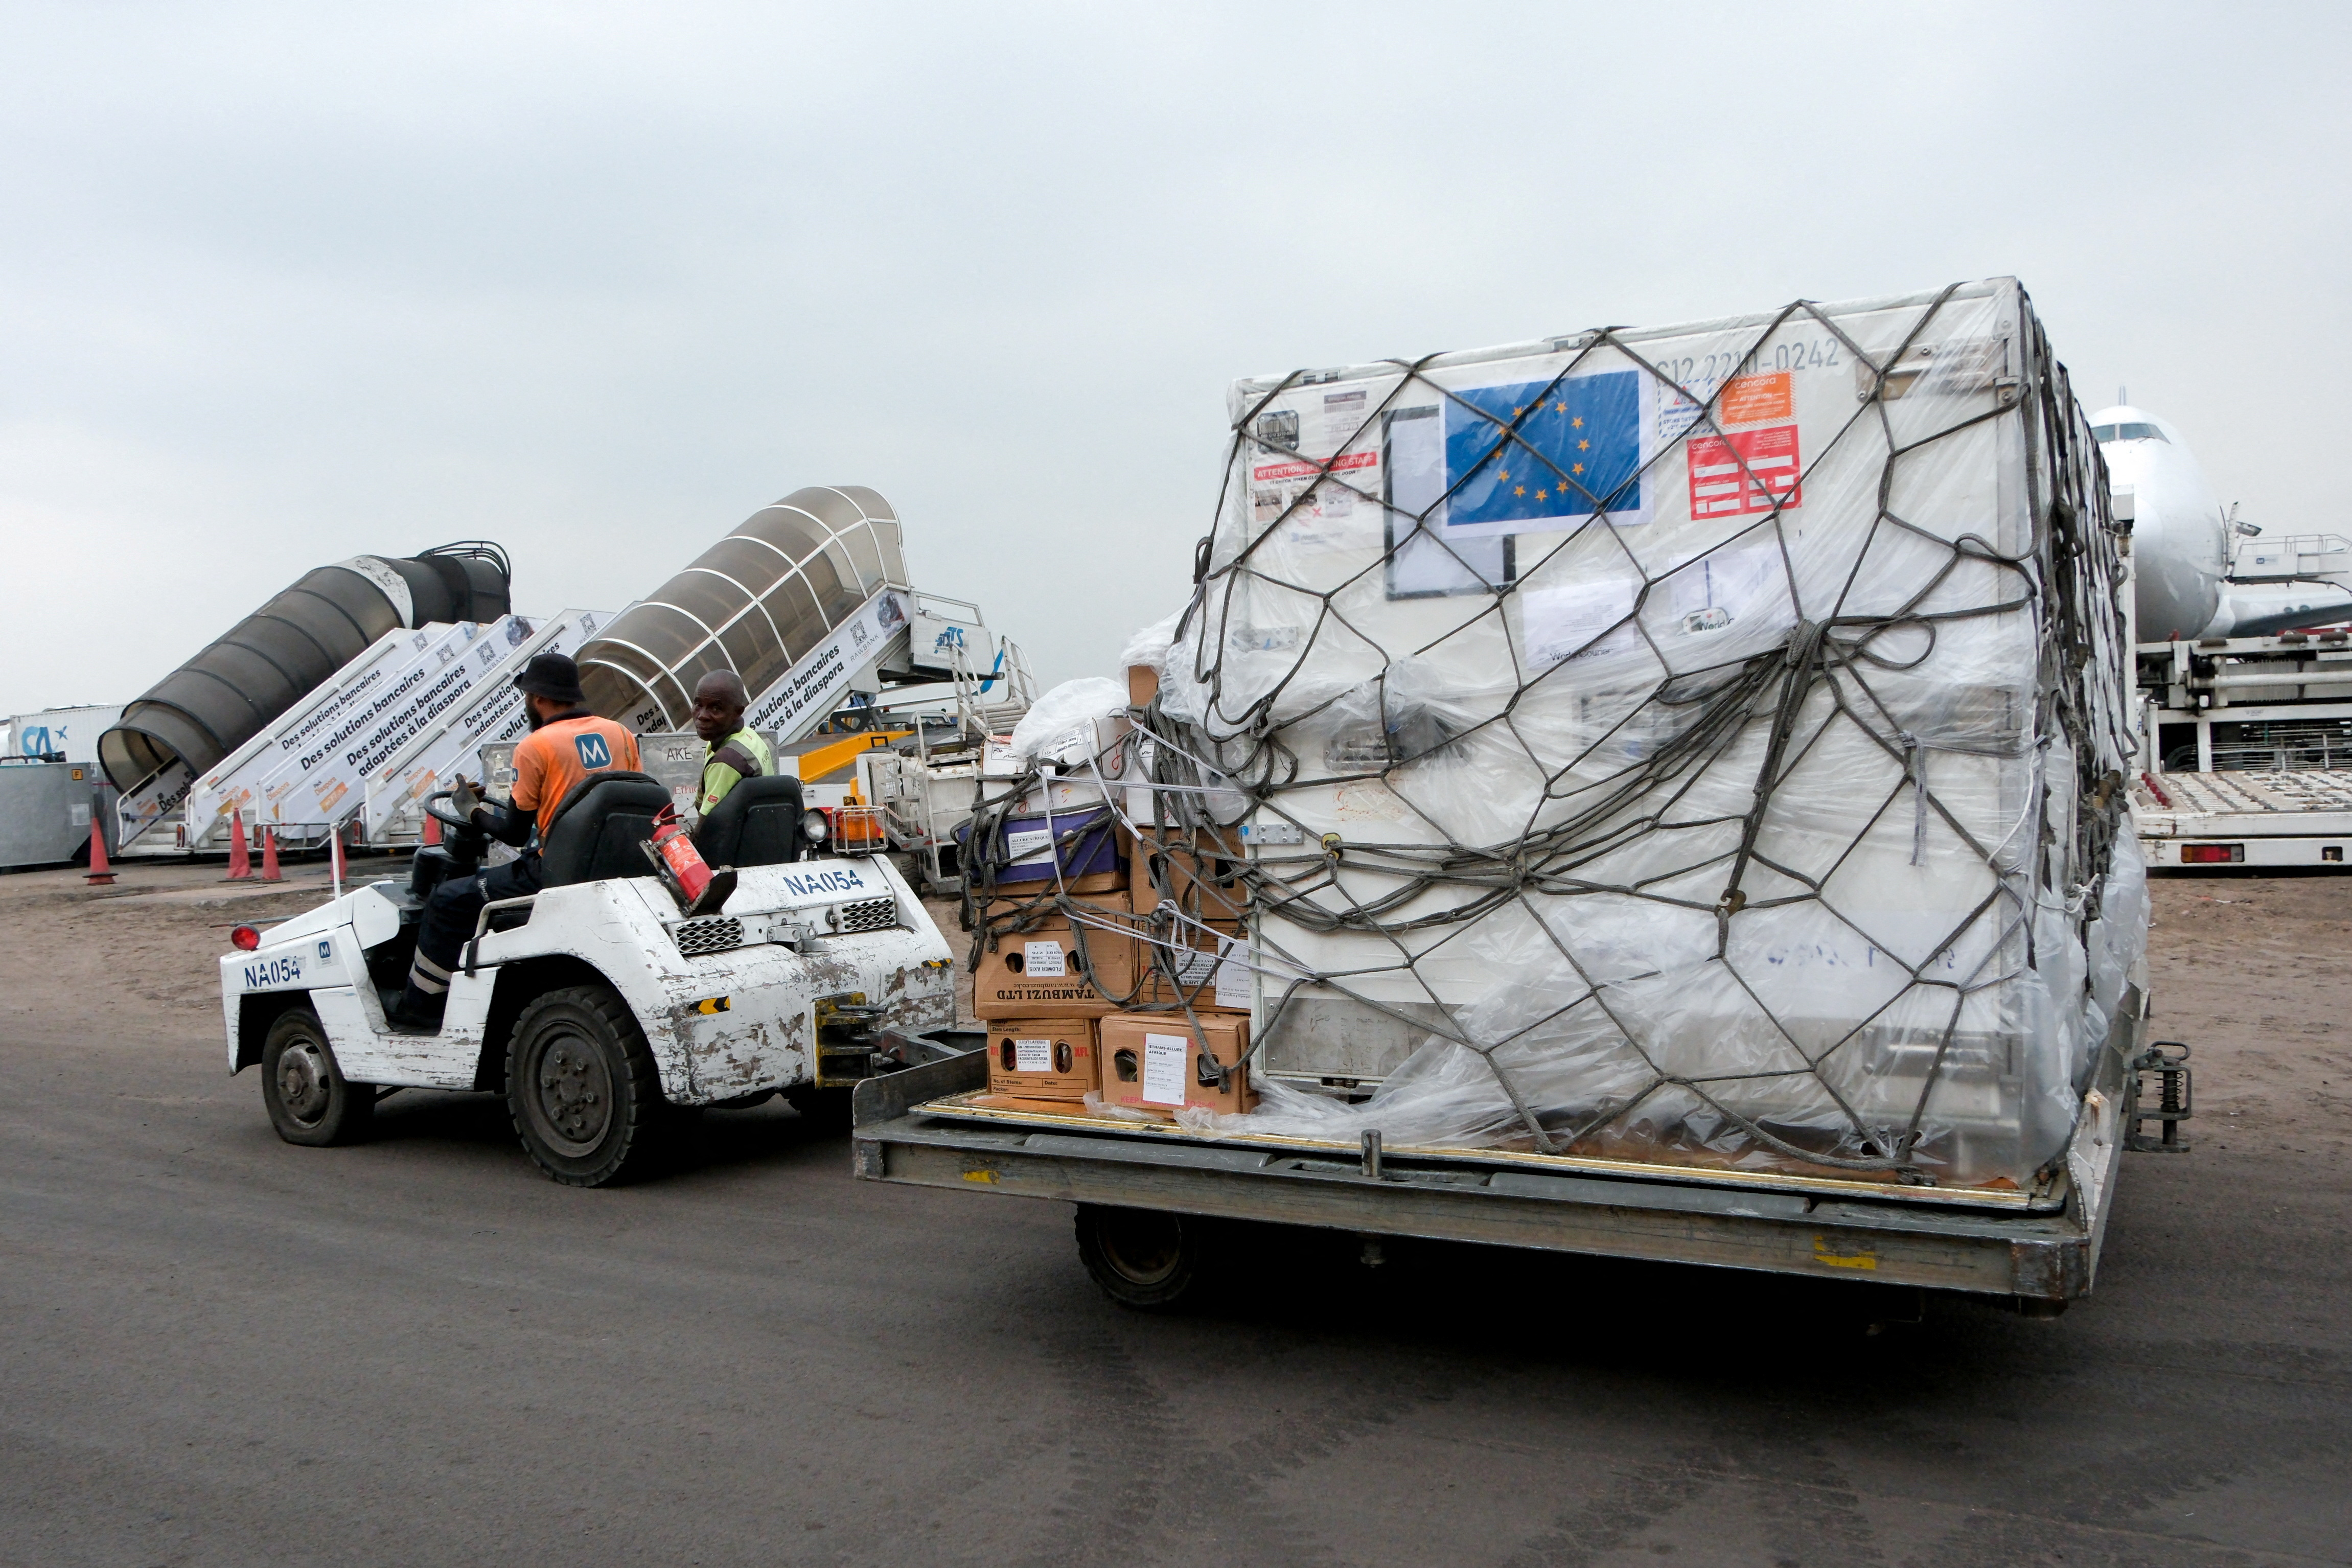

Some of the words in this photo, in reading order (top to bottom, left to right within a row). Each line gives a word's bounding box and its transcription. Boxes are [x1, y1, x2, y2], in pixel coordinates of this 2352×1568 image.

[1735, 377, 1777, 389] cencora
[1739, 393, 1772, 402] ATTENTION
[1257, 465, 1304, 477] ATTENTION:
[850, 633, 879, 662] RAWBANK
[478, 652, 509, 680] RAWBANK
[793, 644, 840, 691] bancaires
[785, 706, 793, 721] à
[792, 698, 803, 713] la
[803, 661, 844, 702] diaspora
[282, 734, 299, 750] Des
[300, 701, 339, 737] solutions
[338, 669, 381, 706] bancaires
[347, 744, 369, 766] Des
[369, 704, 417, 749] solutions
[416, 664, 466, 709] bancaires
[465, 711, 482, 729] Des
[482, 683, 514, 714] solutio
[749, 686, 794, 730] solutions
[300, 750, 324, 771] Des
[324, 709, 374, 753] solutions
[372, 667, 425, 713] bancaires
[475, 700, 514, 737] adaptées
[637, 708, 654, 726] Des
[358, 731, 409, 776] adaptées
[407, 723, 418, 735] à
[415, 717, 428, 730] la
[428, 679, 471, 720] diaspora
[581, 739, 607, 764] M
[667, 747, 693, 761] AKE
[313, 780, 322, 788] Pack
[405, 766, 425, 784] Diaspora
[219, 786, 240, 802] Diaspora
[265, 785, 275, 793] Pack
[266, 782, 290, 801] Diaspora
[314, 776, 337, 796] Diaspora
[158, 795, 176, 812] Des
[783, 869, 864, 895] NA054
[244, 956, 301, 988] NA054
[997, 990, 1024, 1000] LTD
[1027, 989, 1095, 1000] TAMBUZI
[1074, 1047, 1089, 1057] XFL
[1121, 1096, 1139, 1104] KEEP
